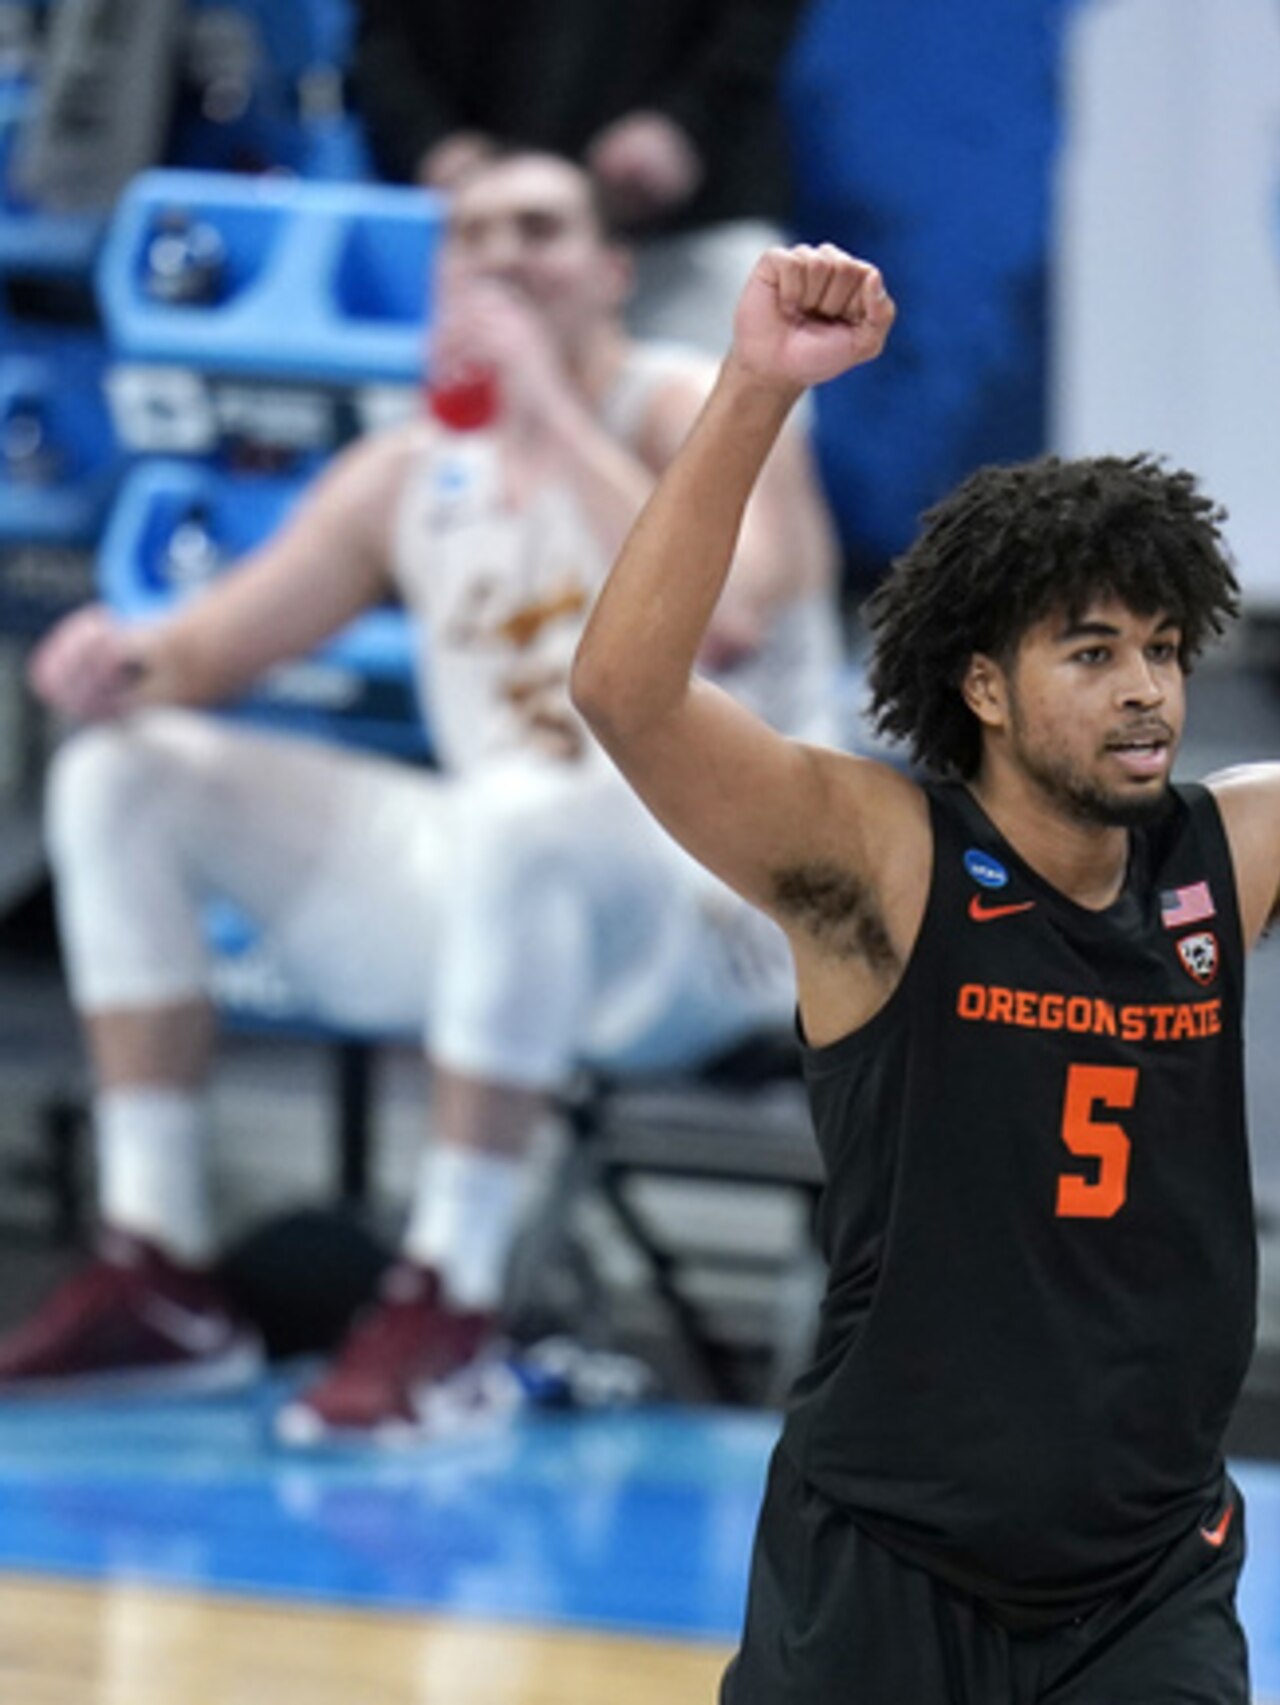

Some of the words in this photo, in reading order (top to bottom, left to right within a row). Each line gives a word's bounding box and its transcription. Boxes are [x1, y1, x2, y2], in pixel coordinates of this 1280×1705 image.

[957, 983, 1117, 1036] OREGON
[1120, 999, 1222, 1041] STATE
[1056, 1063, 1138, 1218] 5
